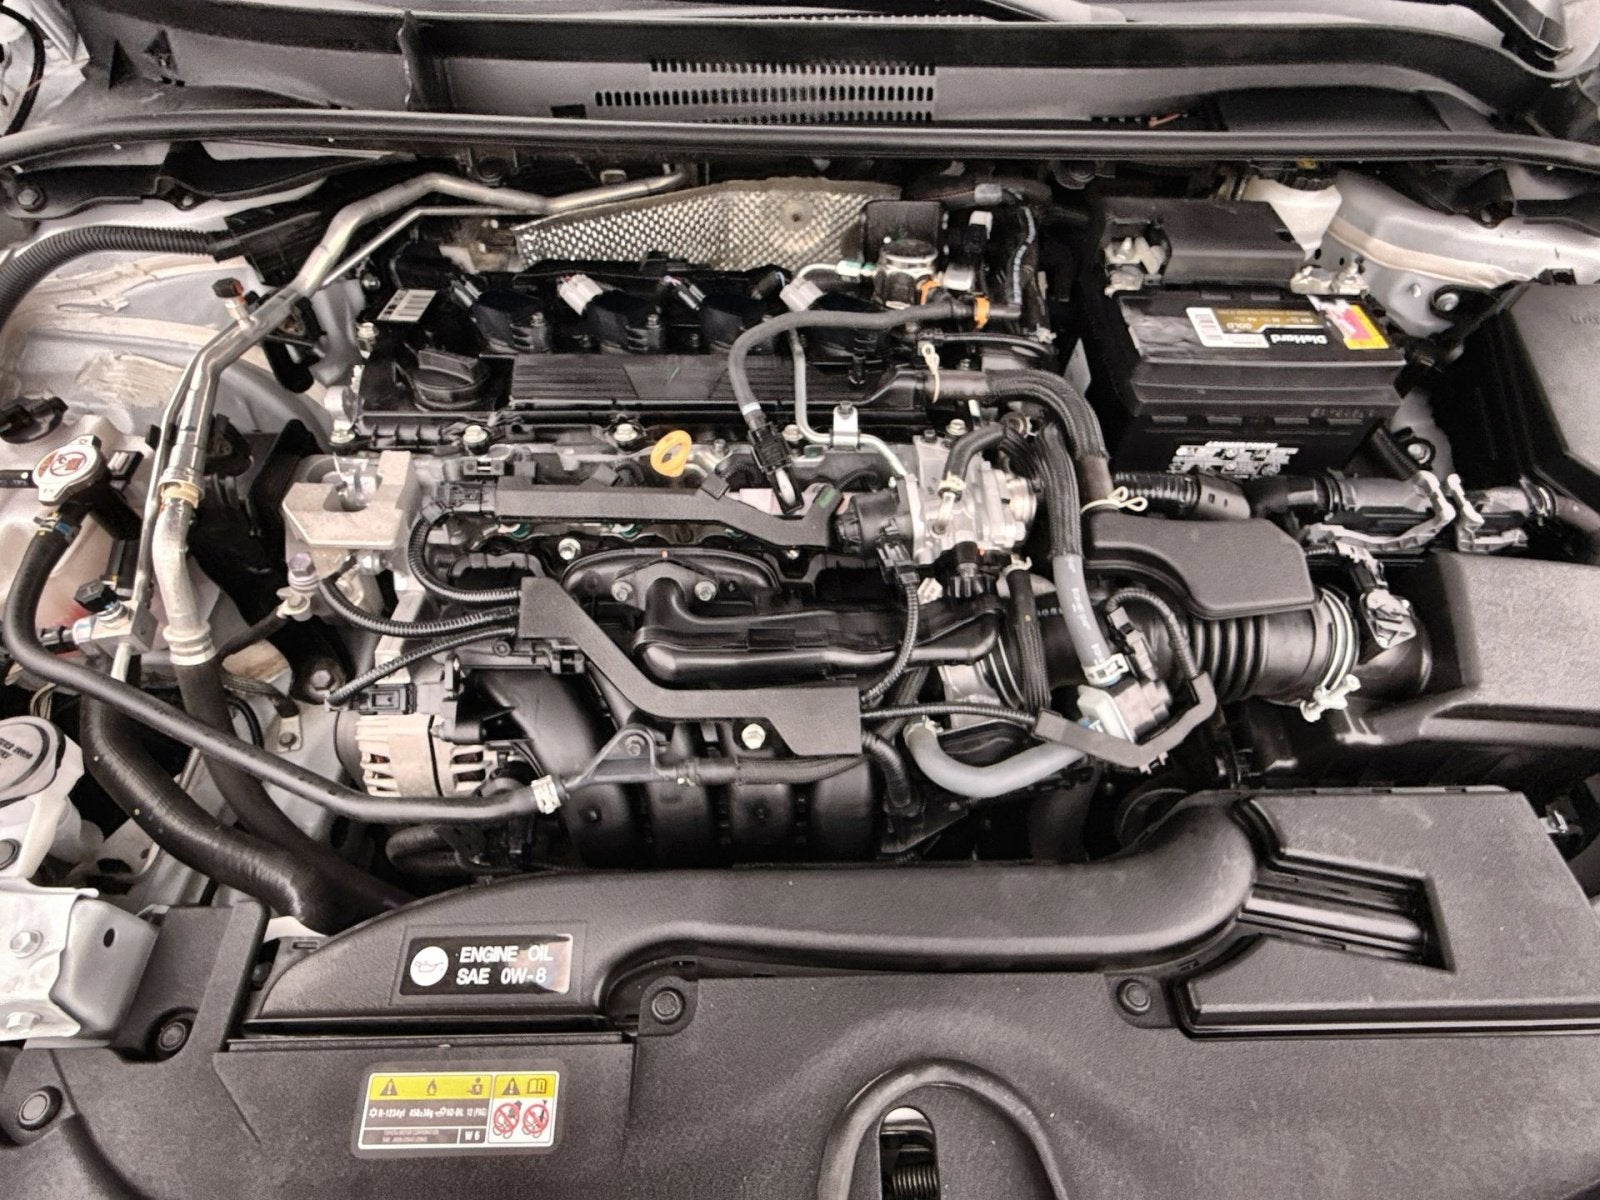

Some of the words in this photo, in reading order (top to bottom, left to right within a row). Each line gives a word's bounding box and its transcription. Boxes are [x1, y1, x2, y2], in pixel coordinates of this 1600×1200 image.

[1270, 333, 1328, 345] DieHard
[459, 945, 518, 963] ENGINE
[527, 944, 554, 961] OIL
[456, 967, 491, 985] SAE
[500, 967, 547, 984] 0W-8
